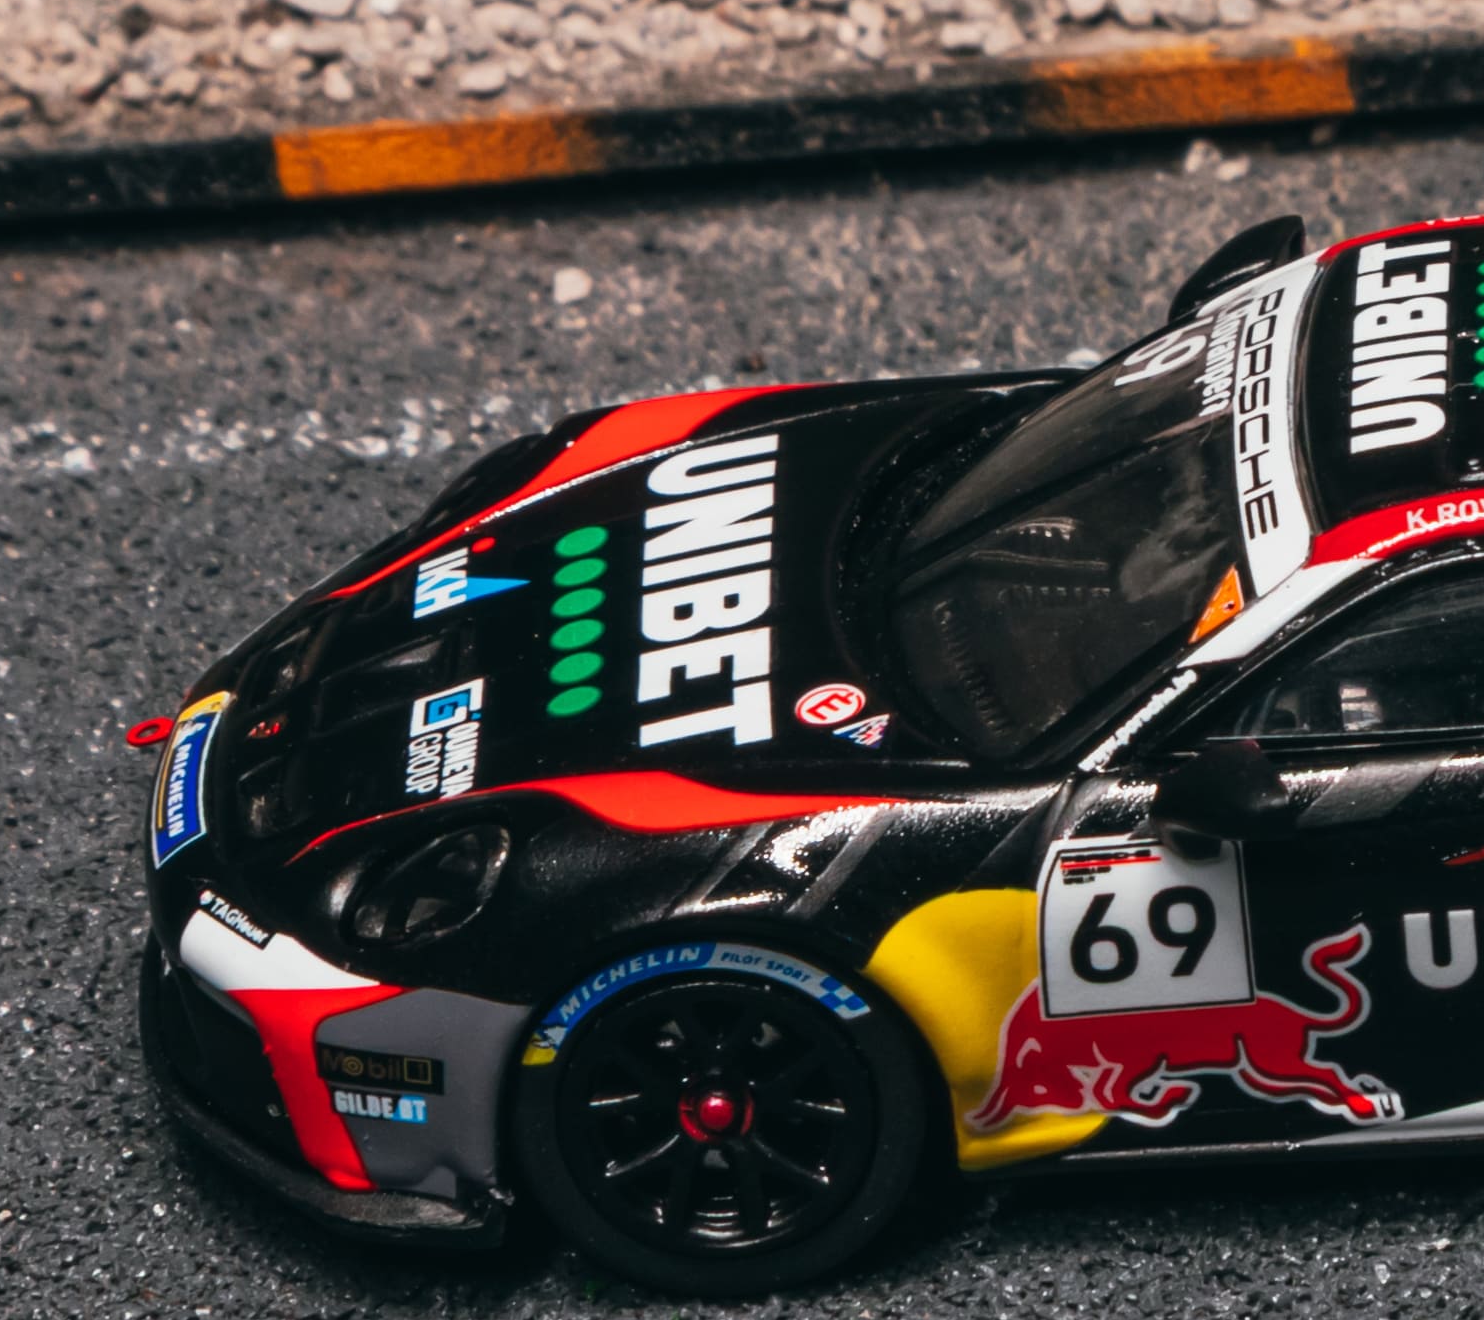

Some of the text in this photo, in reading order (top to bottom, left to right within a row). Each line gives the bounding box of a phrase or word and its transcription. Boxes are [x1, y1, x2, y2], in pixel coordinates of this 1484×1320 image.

[1350, 240, 1452, 454] UNIBET
[1239, 287, 1285, 540] PORSCHE
[638, 434, 779, 747] UNIBET
[167, 743, 193, 839] MICHELIN
[405, 733, 443, 794] GROUP
[559, 946, 812, 1022] MICHELIN PILOT SPORT
[1070, 885, 1216, 984] 69
